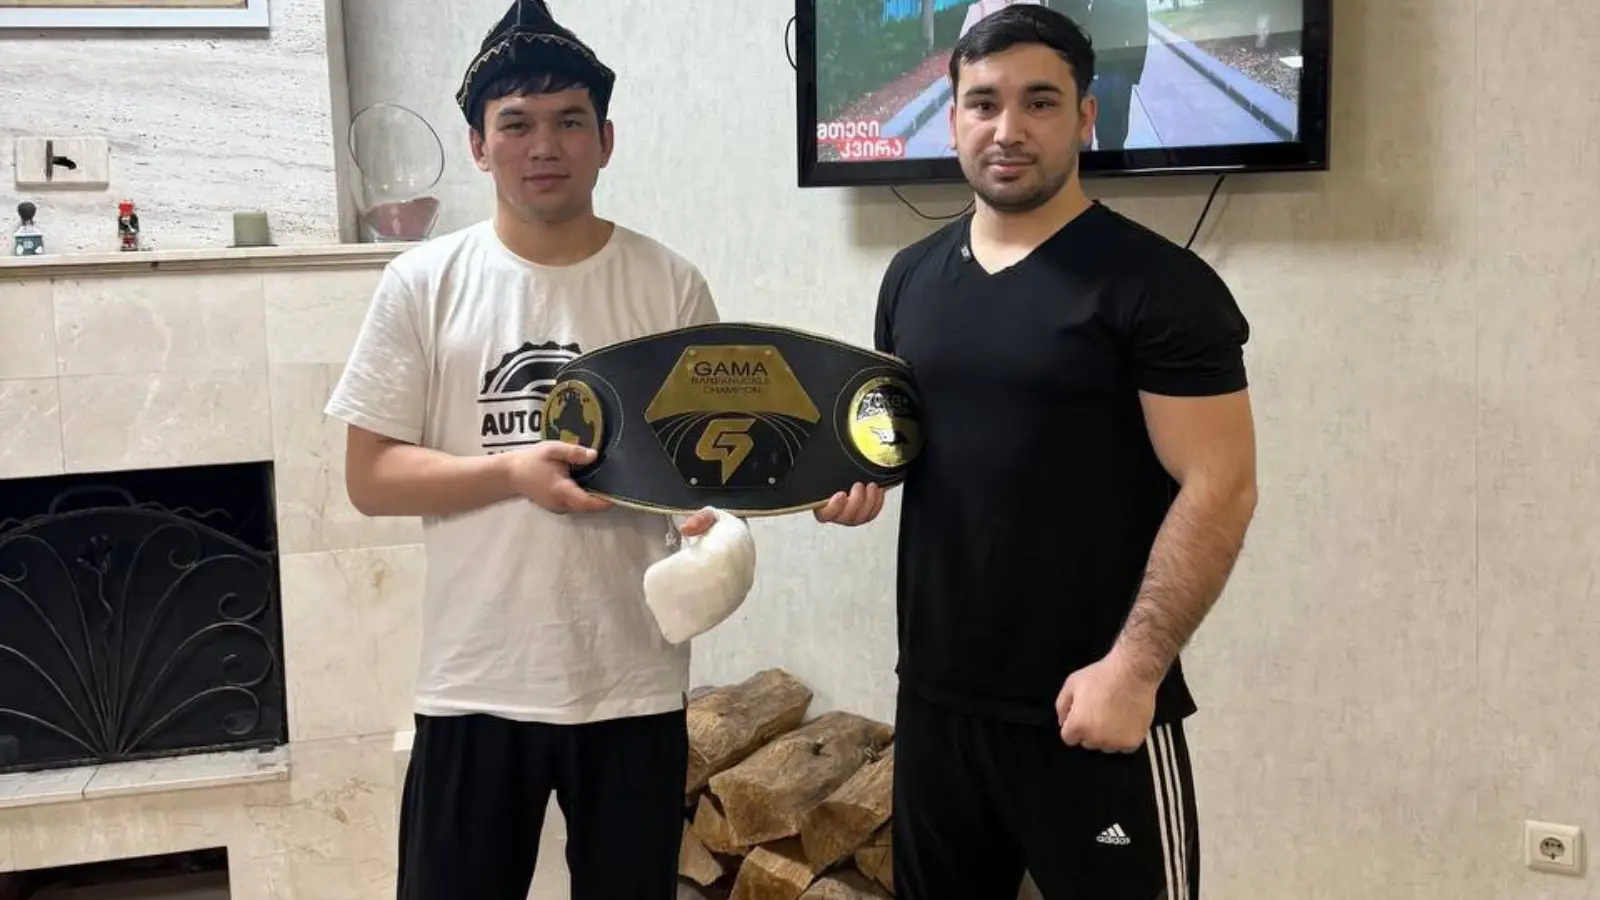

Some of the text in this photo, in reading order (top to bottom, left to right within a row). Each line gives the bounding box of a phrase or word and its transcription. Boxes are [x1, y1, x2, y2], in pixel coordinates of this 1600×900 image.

[839, 140, 903, 158] კვირა
[694, 361, 768, 376] GAMA
[1096, 835, 1131, 845] adidas
